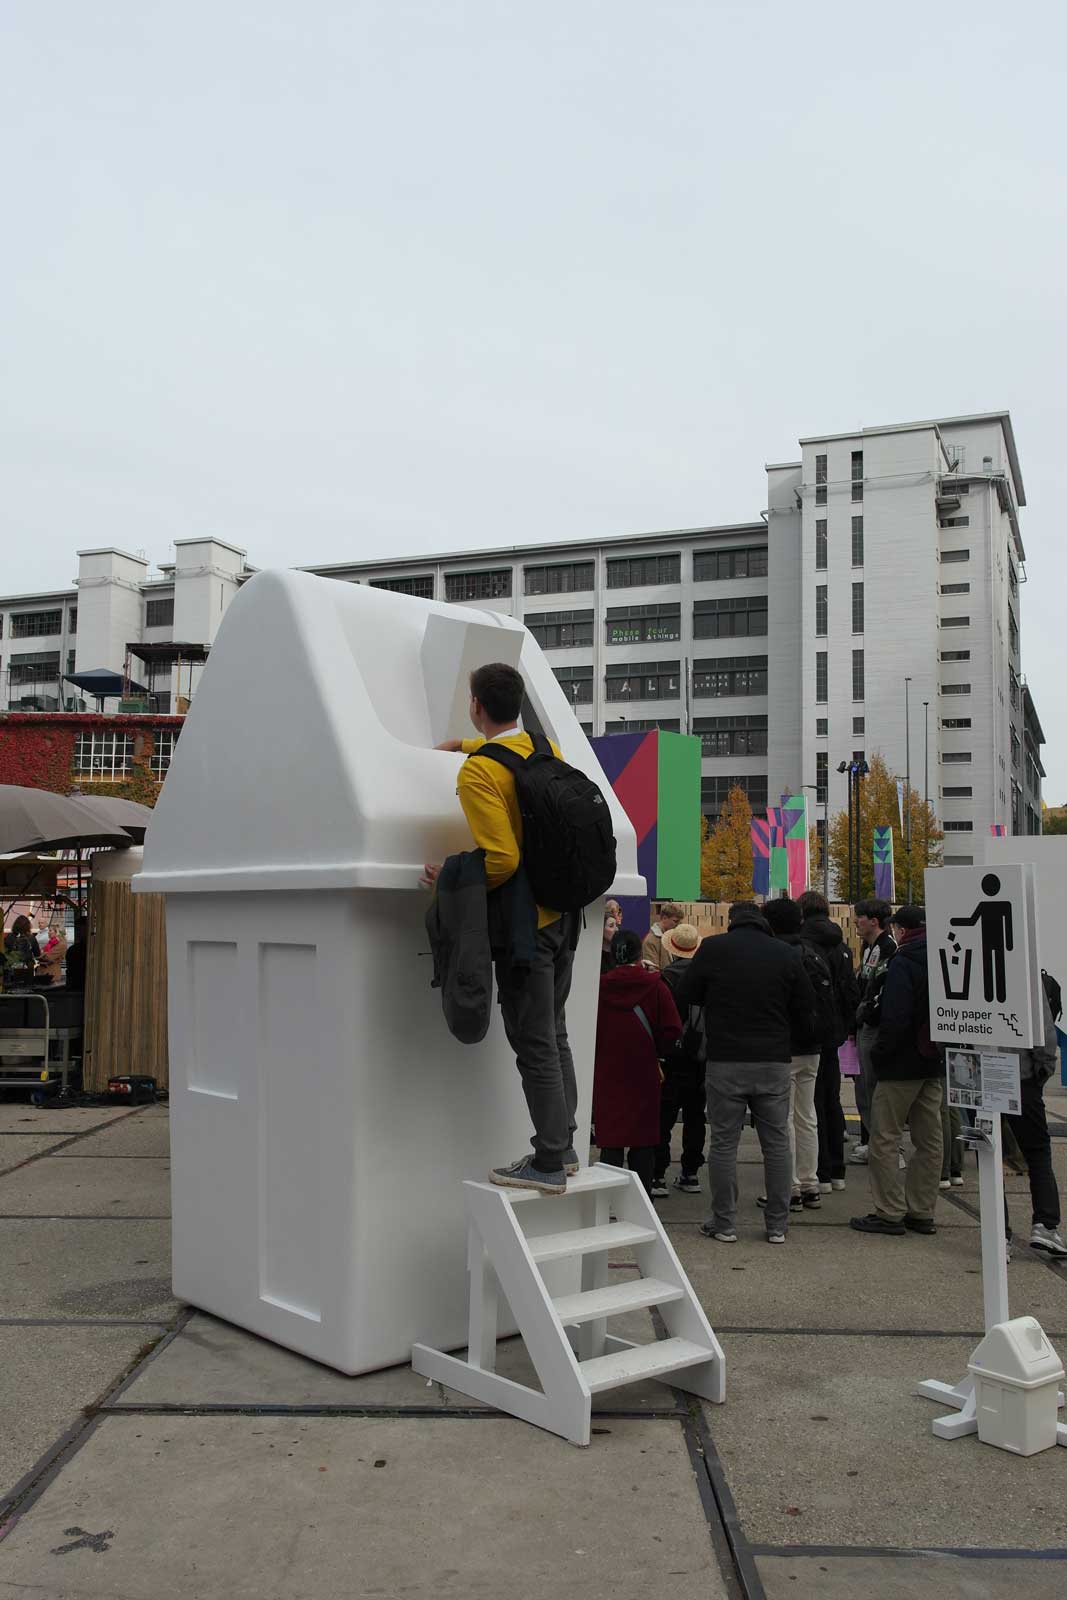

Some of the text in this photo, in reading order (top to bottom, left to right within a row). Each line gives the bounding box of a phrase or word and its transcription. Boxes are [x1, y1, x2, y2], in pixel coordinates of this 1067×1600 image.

[936, 1006, 992, 1021] Only paper
[937, 1022, 993, 1034] and plastic
